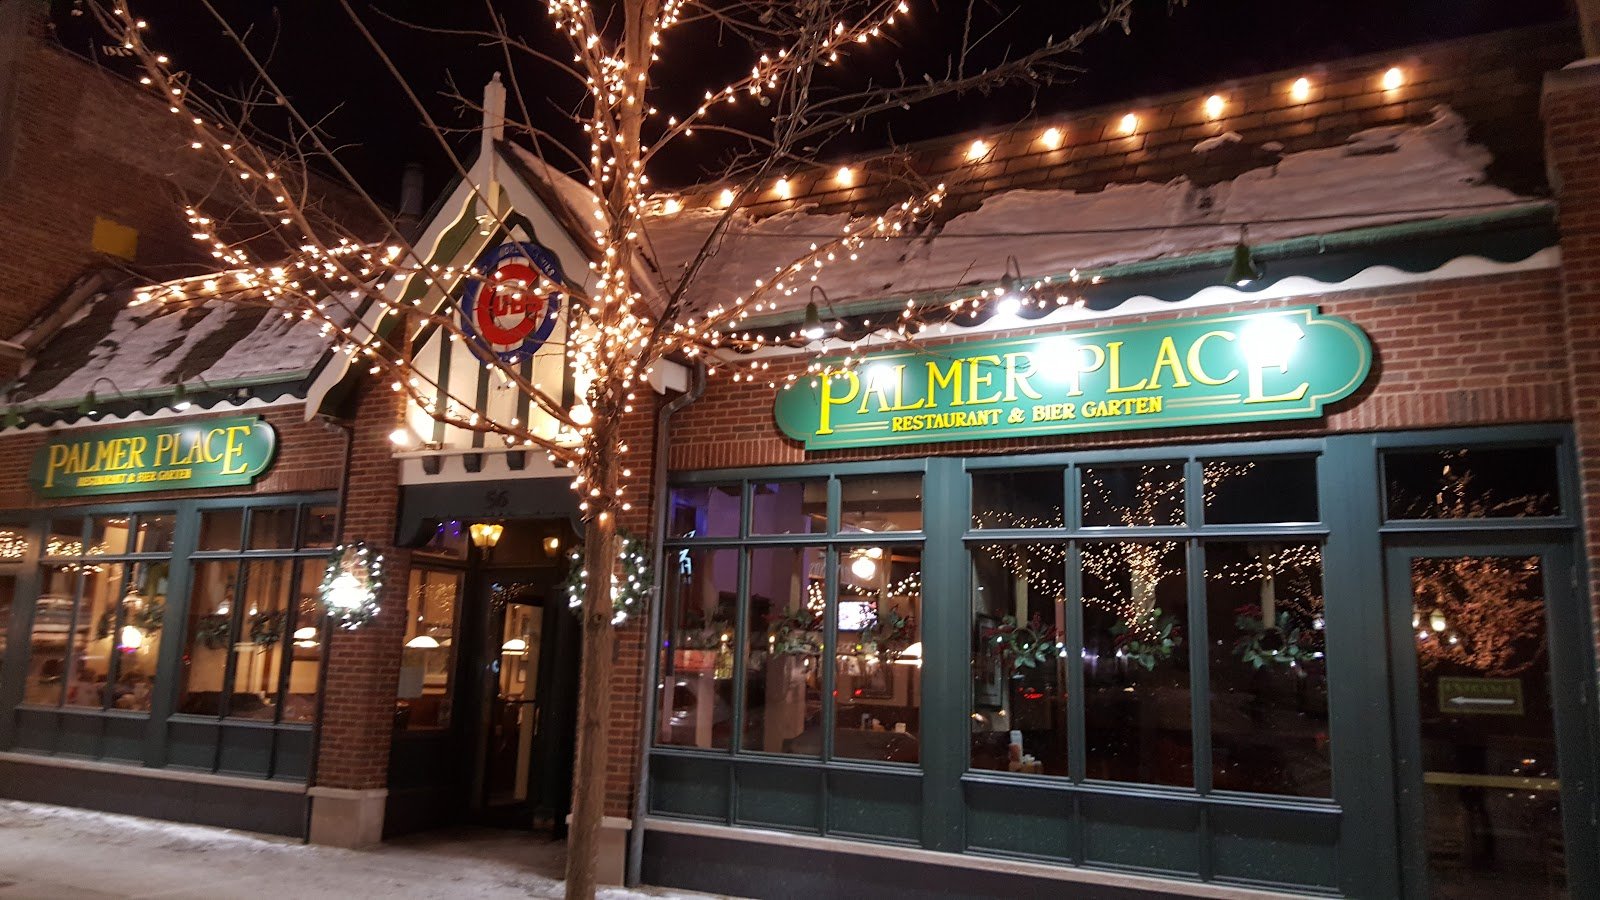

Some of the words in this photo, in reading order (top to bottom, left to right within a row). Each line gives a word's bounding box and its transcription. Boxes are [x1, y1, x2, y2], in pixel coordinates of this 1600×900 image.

[815, 351, 1043, 435] PALMER
[1066, 320, 1310, 404] PLACE
[891, 408, 1003, 433] RESTAURANT
[1007, 407, 1026, 424] &
[1032, 402, 1076, 422] BIER
[1080, 395, 1164, 419] GARTEN
[43, 436, 149, 489] PALMER
[153, 425, 251, 475] PLACE
